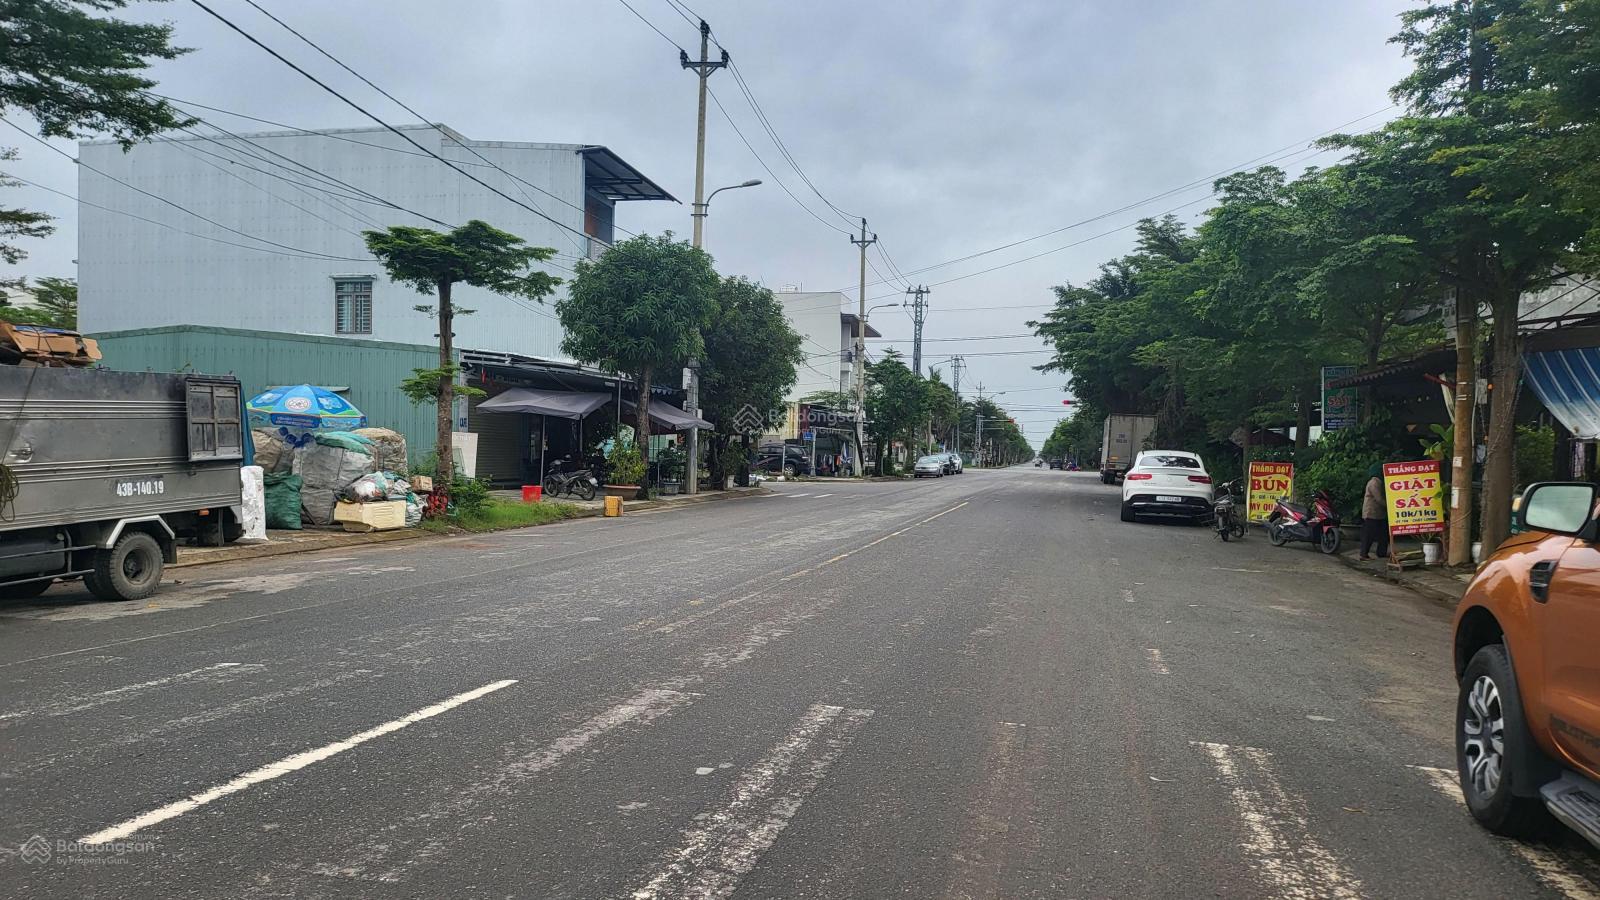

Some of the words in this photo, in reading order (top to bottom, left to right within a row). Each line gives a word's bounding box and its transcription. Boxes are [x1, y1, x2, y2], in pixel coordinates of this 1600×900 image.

[116, 480, 164, 497] 43B-140.19
[1251, 476, 1289, 491] BÚN
[1389, 477, 1436, 492] GIẶT
[1395, 493, 1434, 509] SẤY
